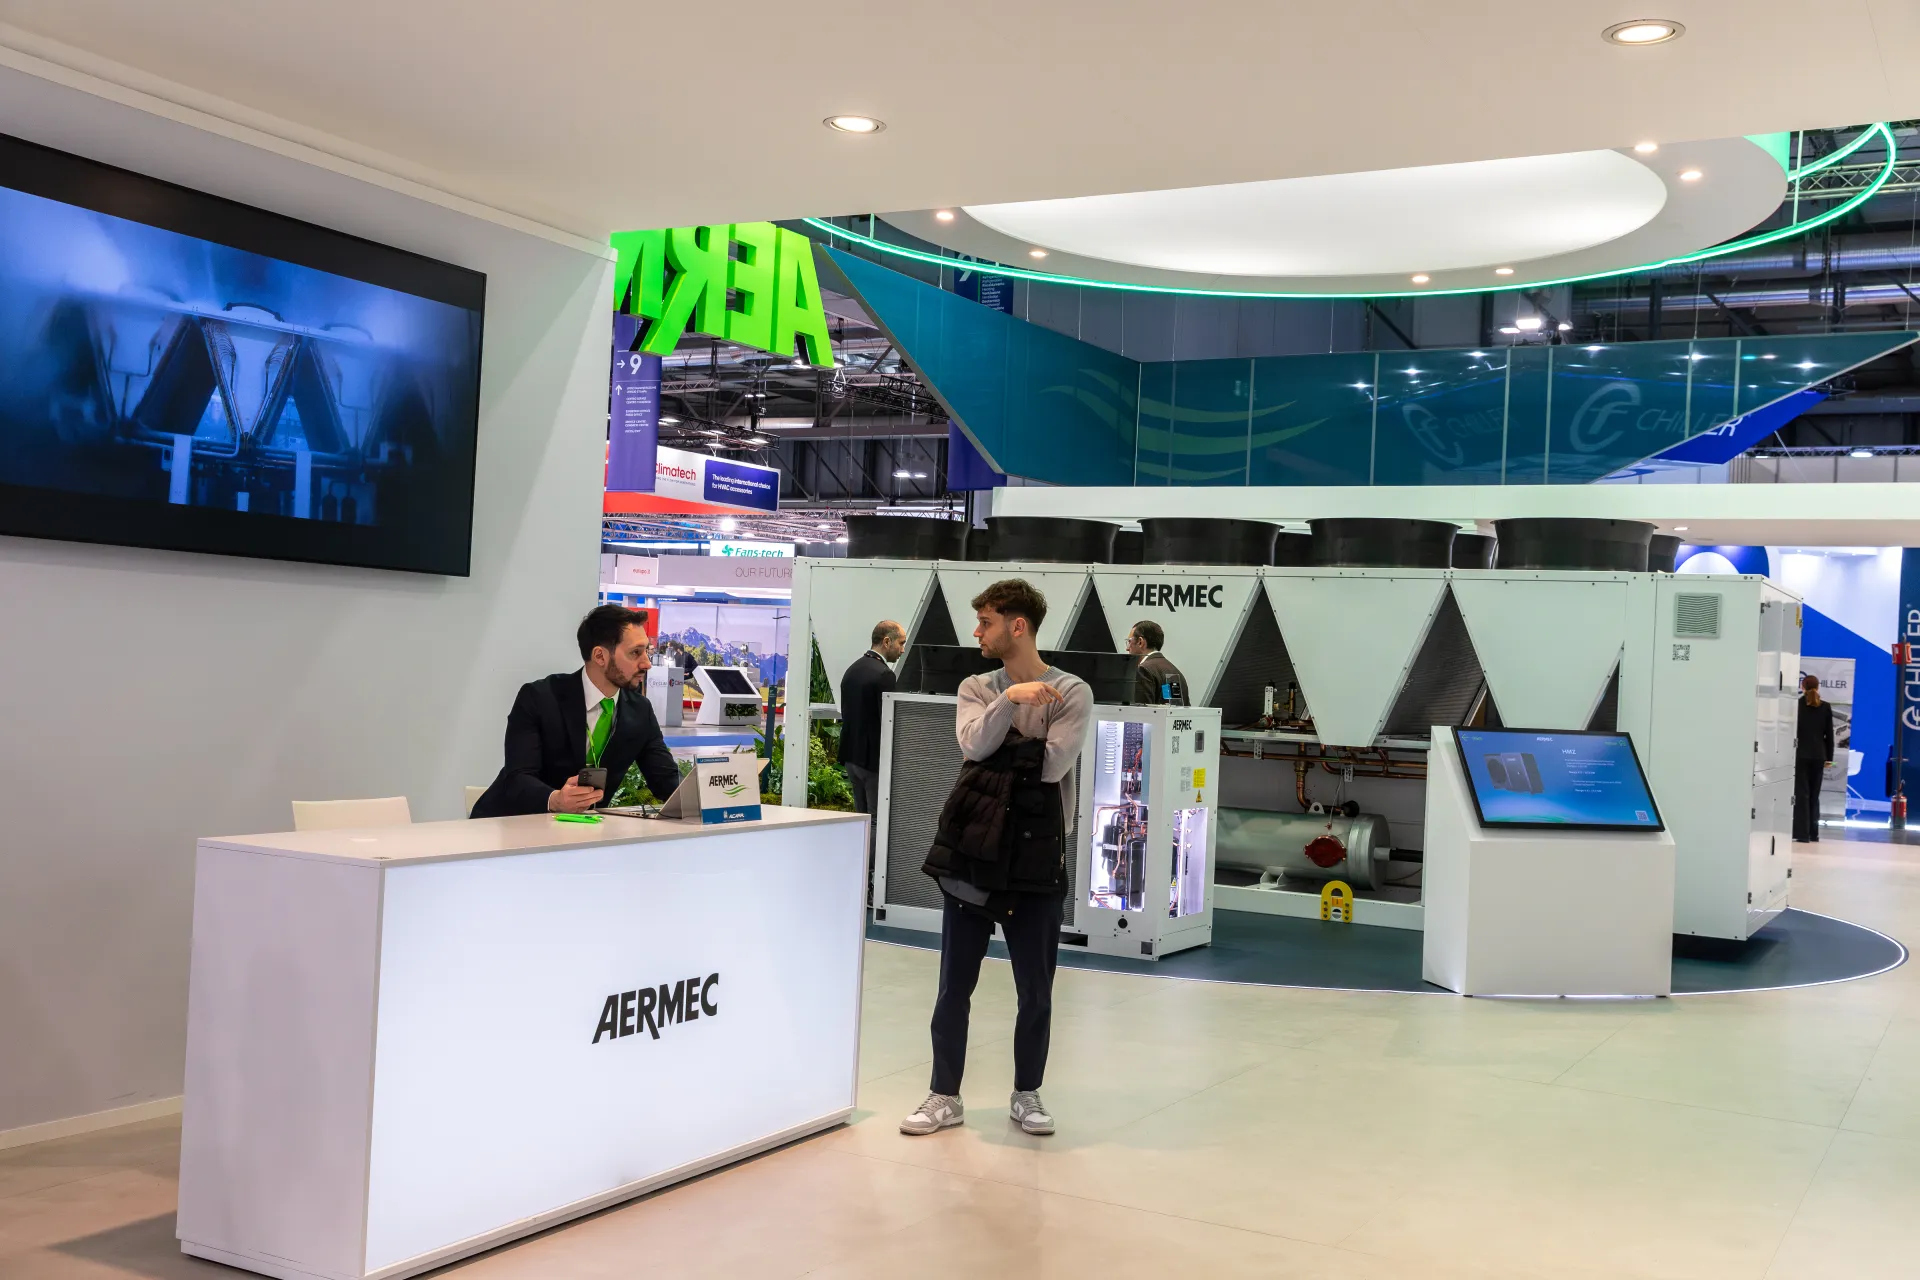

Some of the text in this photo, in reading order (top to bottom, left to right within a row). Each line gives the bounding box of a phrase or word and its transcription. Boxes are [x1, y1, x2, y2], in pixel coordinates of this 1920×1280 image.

[629, 354, 642, 375] 9
[655, 463, 697, 481] limatech
[712, 473, 720, 481] The
[720, 476, 735, 484] leading
[735, 479, 758, 487] international
[718, 483, 730, 491] HVAC
[730, 486, 752, 494] accessories
[735, 547, 784, 558] Fans-tech
[735, 567, 757, 578] OUR
[1126, 584, 1223, 612] AERMEC
[1818, 679, 1848, 689] HILLER
[1172, 719, 1192, 733] AERMEC
[708, 774, 739, 789] AERMEC
[591, 972, 719, 1045] AERMEC
